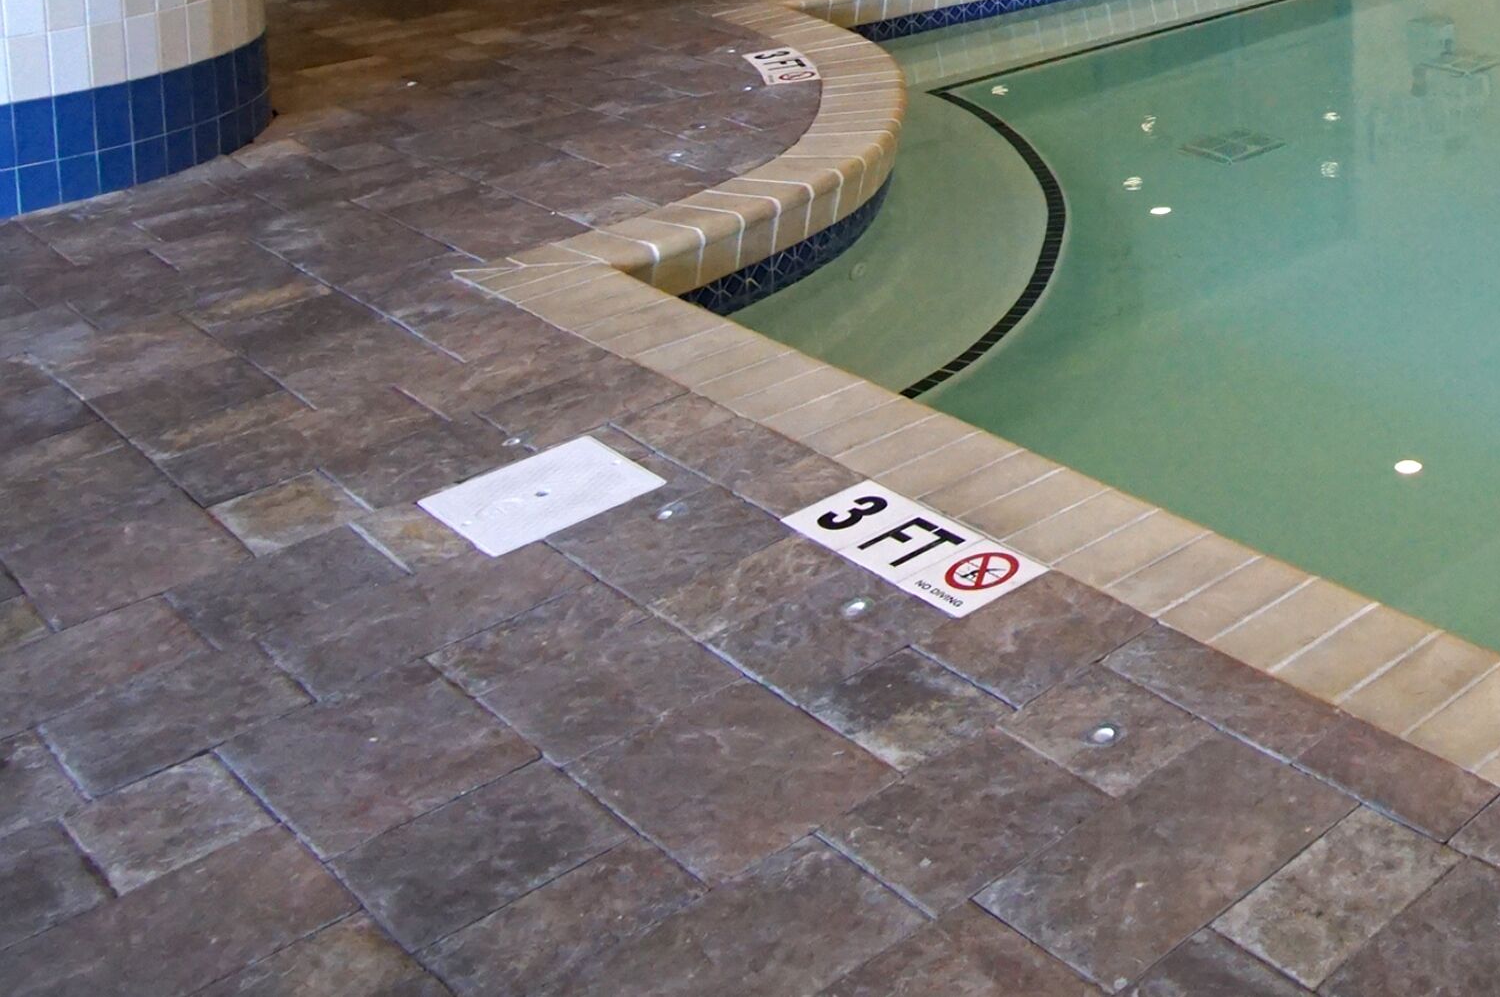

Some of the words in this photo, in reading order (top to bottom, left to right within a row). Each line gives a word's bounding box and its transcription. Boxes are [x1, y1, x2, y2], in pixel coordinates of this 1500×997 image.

[817, 495, 889, 531] 3
[857, 516, 966, 567] FT
[914, 579, 932, 591] NO
[930, 587, 964, 608] DIVING
